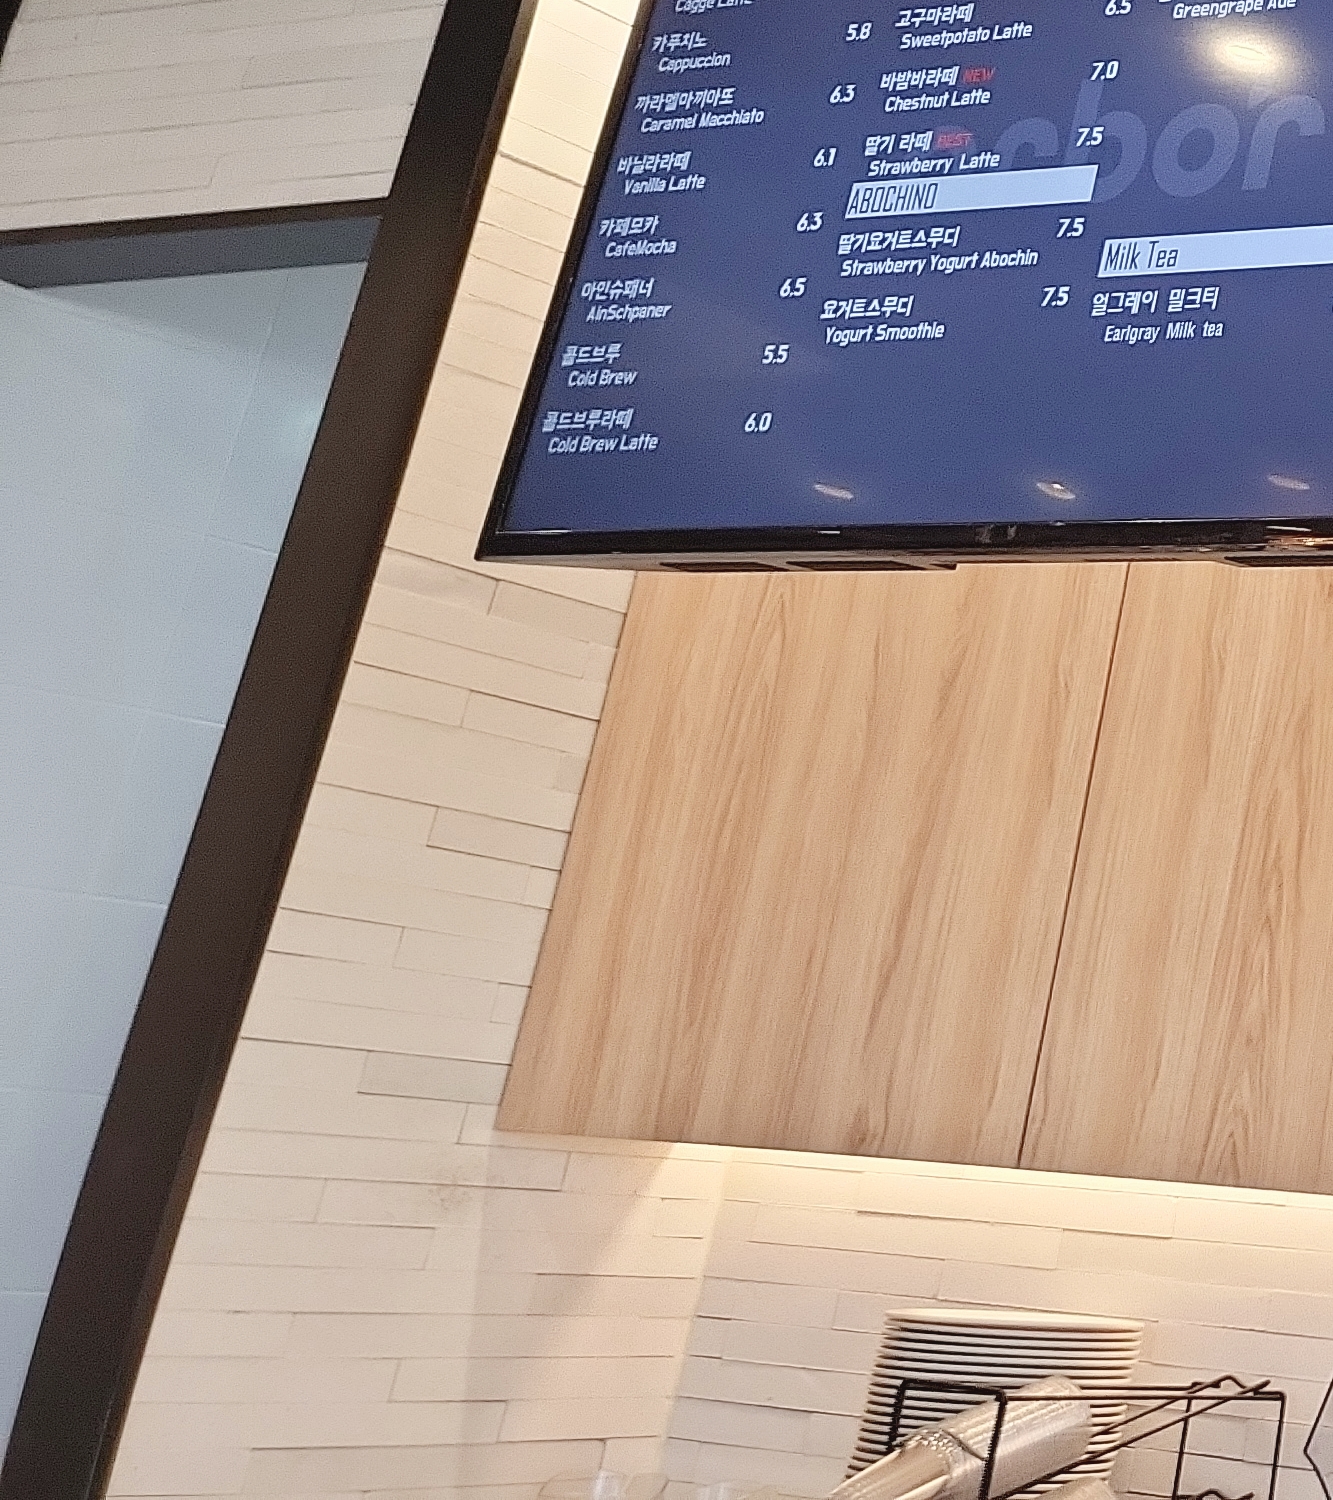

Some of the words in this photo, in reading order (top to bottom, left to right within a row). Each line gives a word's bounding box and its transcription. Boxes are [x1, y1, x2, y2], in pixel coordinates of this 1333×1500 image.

[1173, 0, 1263, 18] Greengrape
[848, 183, 938, 214] ABOCHINO
[838, 226, 960, 254] 딸기요거트스무디
[1057, 218, 1084, 237] 7.5
[841, 258, 926, 276] Strawberry
[931, 252, 978, 273] Yogurt
[980, 249, 1038, 267] Abochin
[1105, 243, 1140, 270] Milk
[1148, 241, 1178, 268] Tea
[1092, 291, 1158, 316] 얼그레이
[1168, 287, 1219, 312] 밀크티
[1104, 325, 1160, 344] Earlgray
[1166, 322, 1196, 338] Milk
[1203, 322, 1223, 336] tea
[568, 370, 598, 386] Cold
[599, 369, 637, 384] Brew
